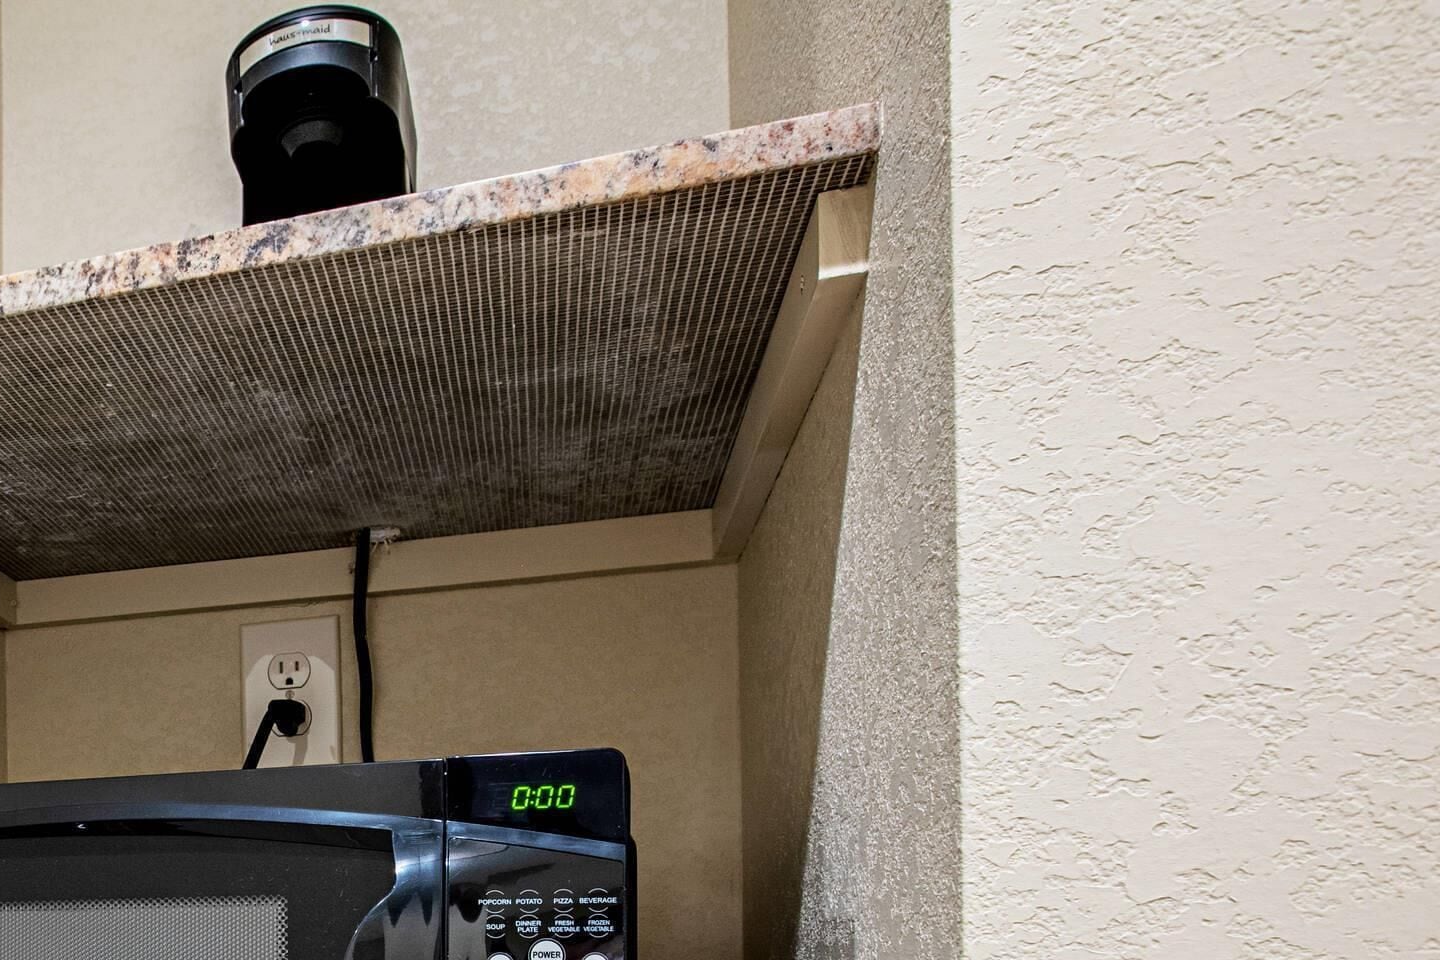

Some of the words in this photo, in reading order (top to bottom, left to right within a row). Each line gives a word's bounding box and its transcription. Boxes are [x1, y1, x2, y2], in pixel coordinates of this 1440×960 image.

[512, 785, 576, 810] 0:00
[478, 898, 512, 906] POPCORN
[532, 951, 561, 959] POWER
